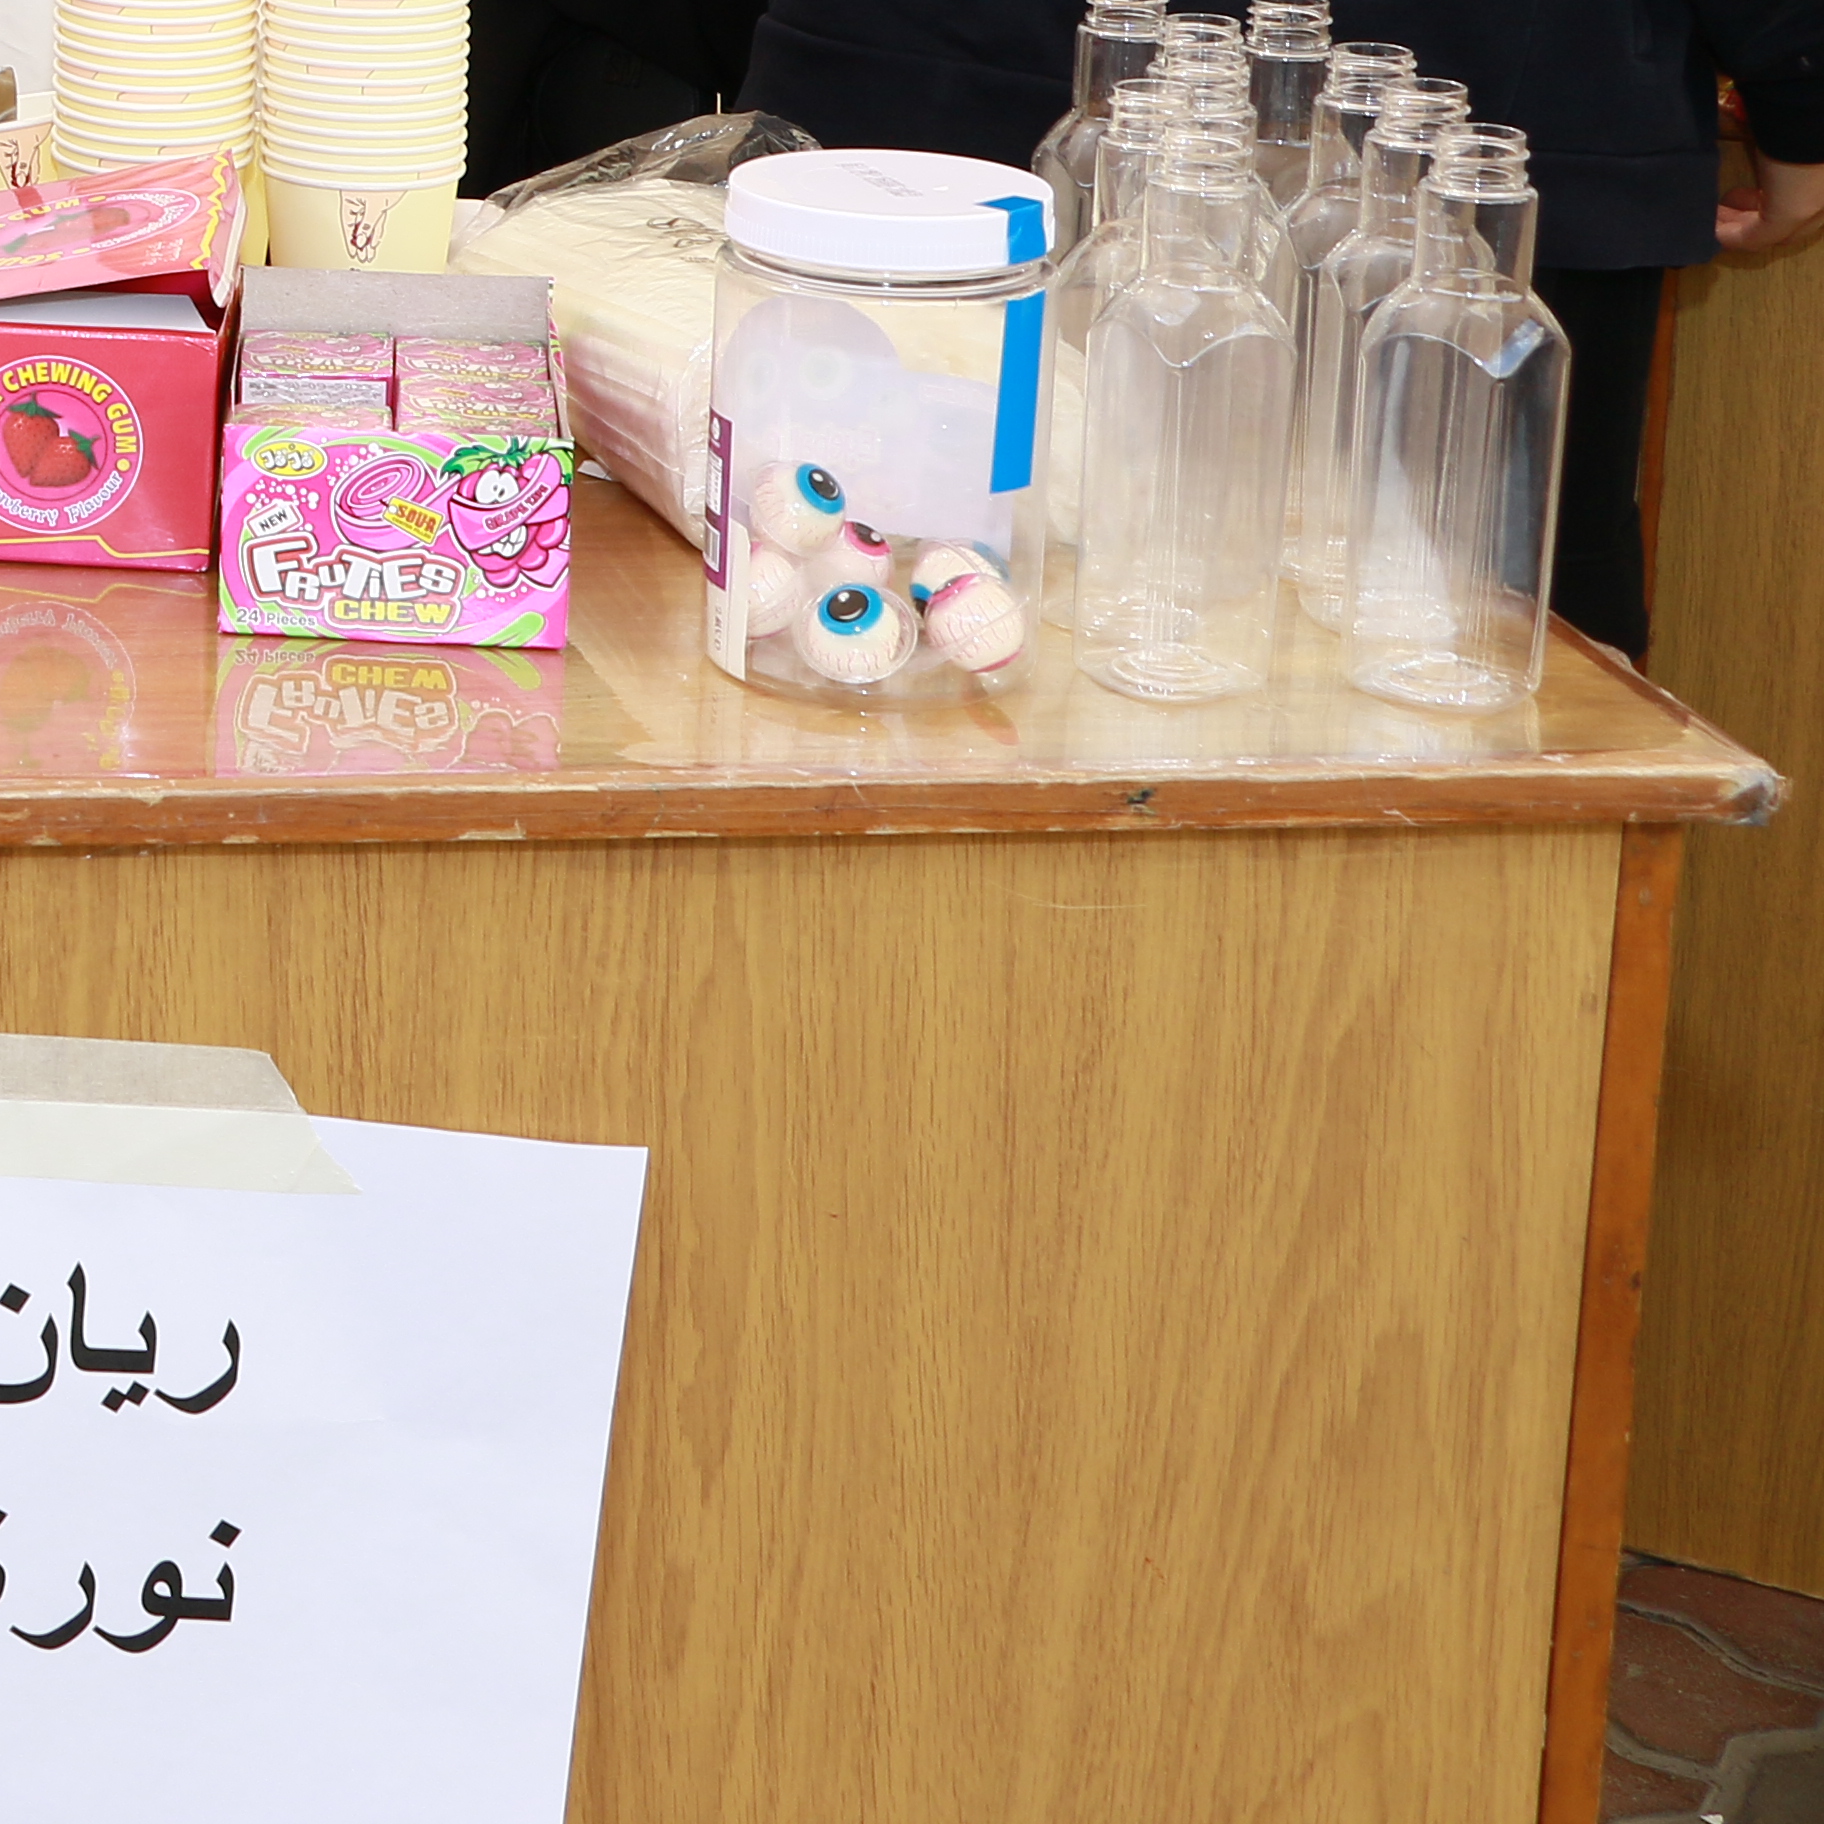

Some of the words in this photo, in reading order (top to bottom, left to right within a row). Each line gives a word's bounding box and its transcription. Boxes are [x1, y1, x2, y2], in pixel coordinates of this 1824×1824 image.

[1, 361, 112, 406] CHEWING
[105, 401, 139, 454] GUM
[65, 470, 124, 525] Flavour
[258, 509, 289, 533] NEW
[394, 502, 439, 534] SOUR
[236, 607, 260, 625] 24
[265, 610, 316, 627] Pieces
[333, 597, 452, 626] CHEW
